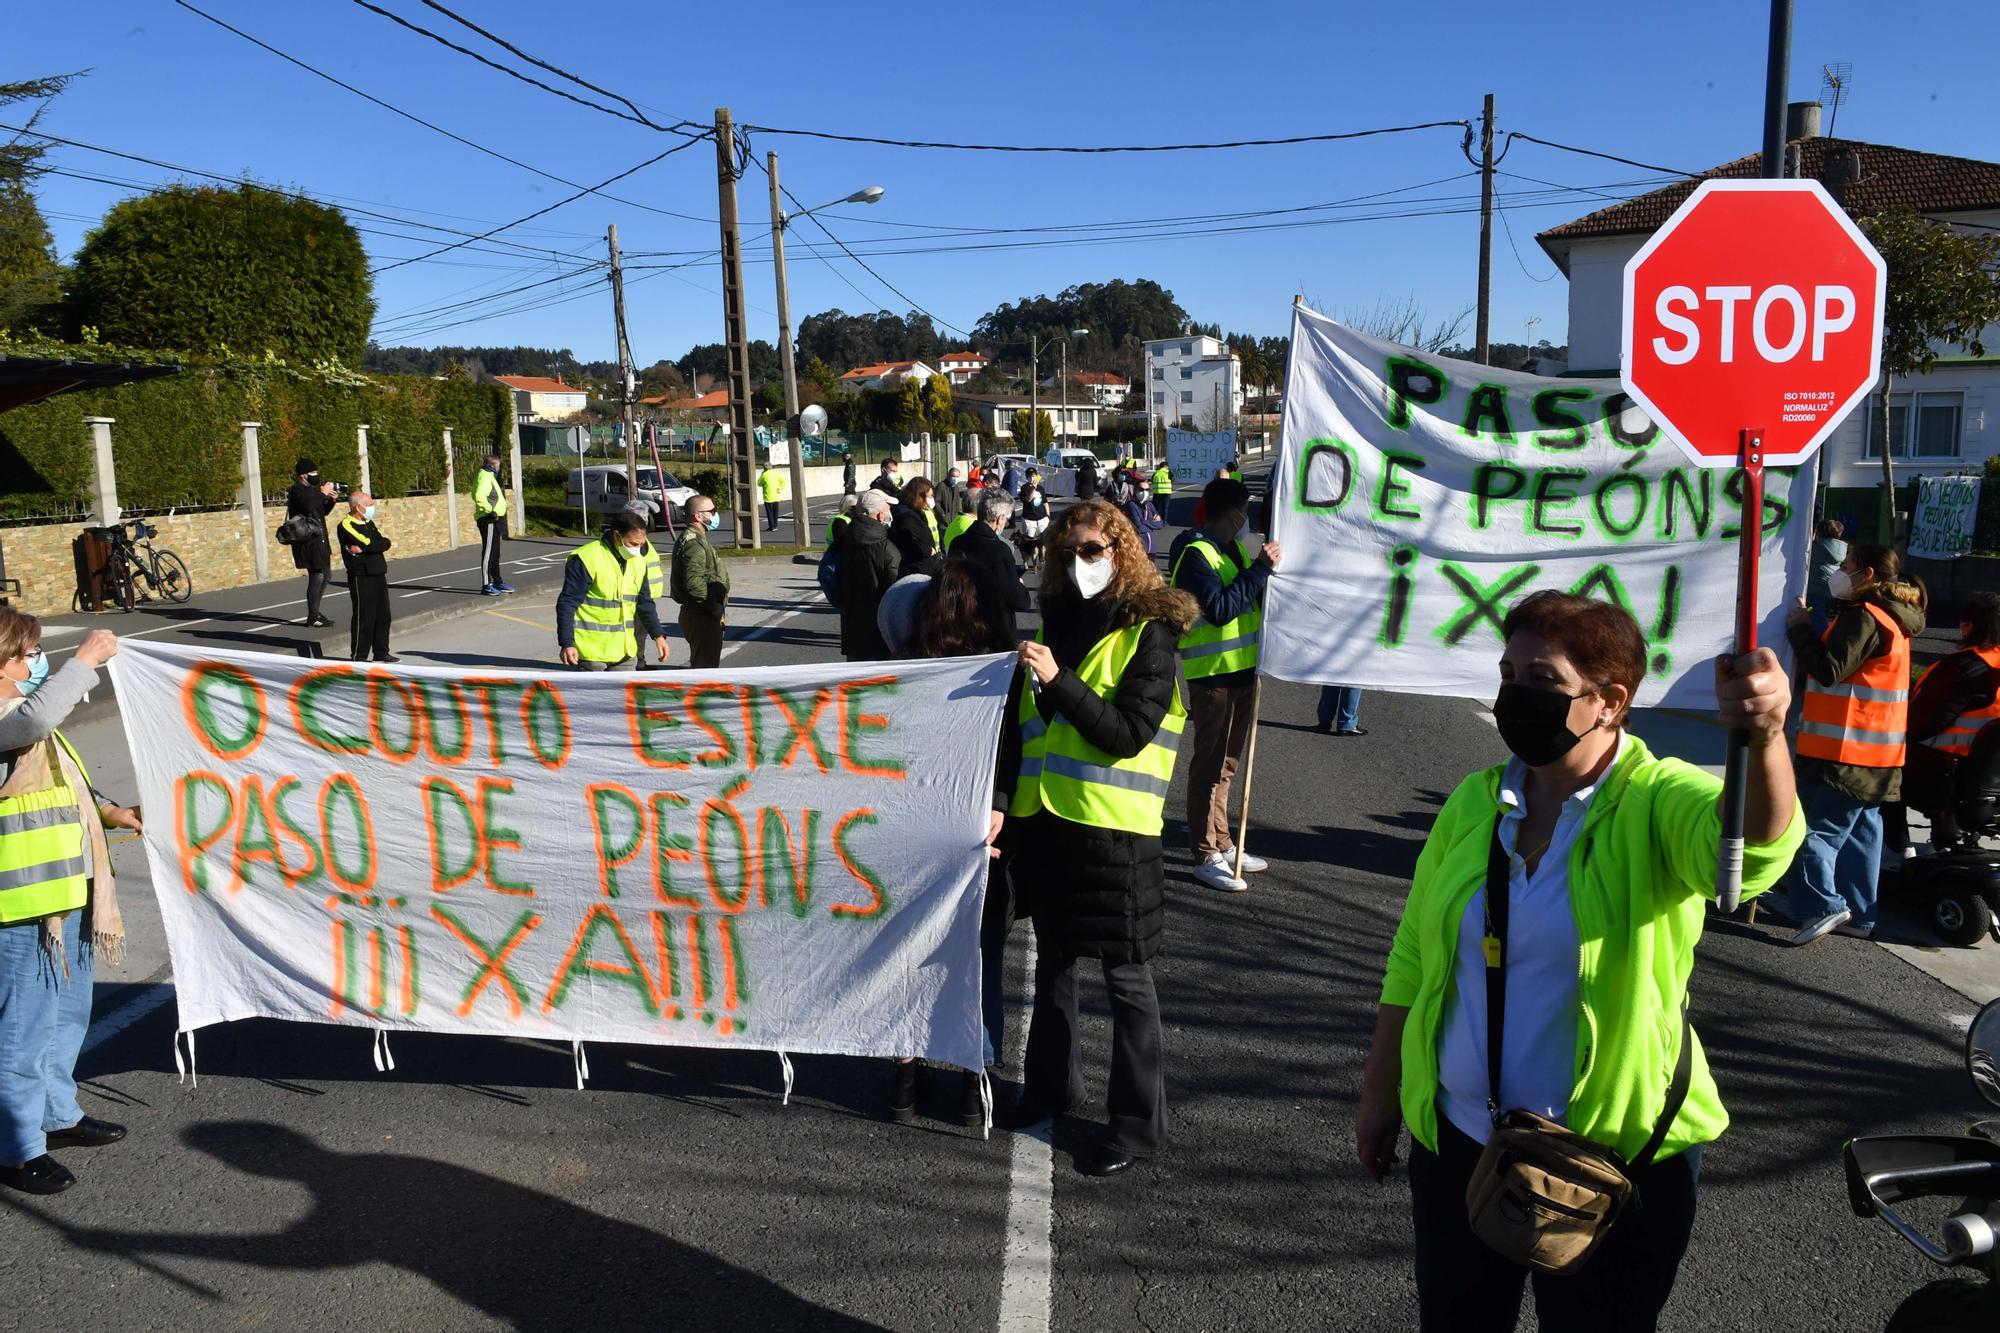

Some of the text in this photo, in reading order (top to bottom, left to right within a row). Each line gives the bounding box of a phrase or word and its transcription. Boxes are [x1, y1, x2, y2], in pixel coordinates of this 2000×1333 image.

[1652, 284, 1856, 365] STOP
[1385, 355, 1662, 451] PASO
[1782, 414, 1816, 422] RD20060
[1784, 392, 1835, 400] ISO 7010:2012
[1293, 437, 1799, 543] DE PEÓNS
[1920, 481, 1934, 504] OS
[180, 661, 906, 779] O COUTO ESIXE
[174, 771, 891, 922] PASO DE PEÓNS
